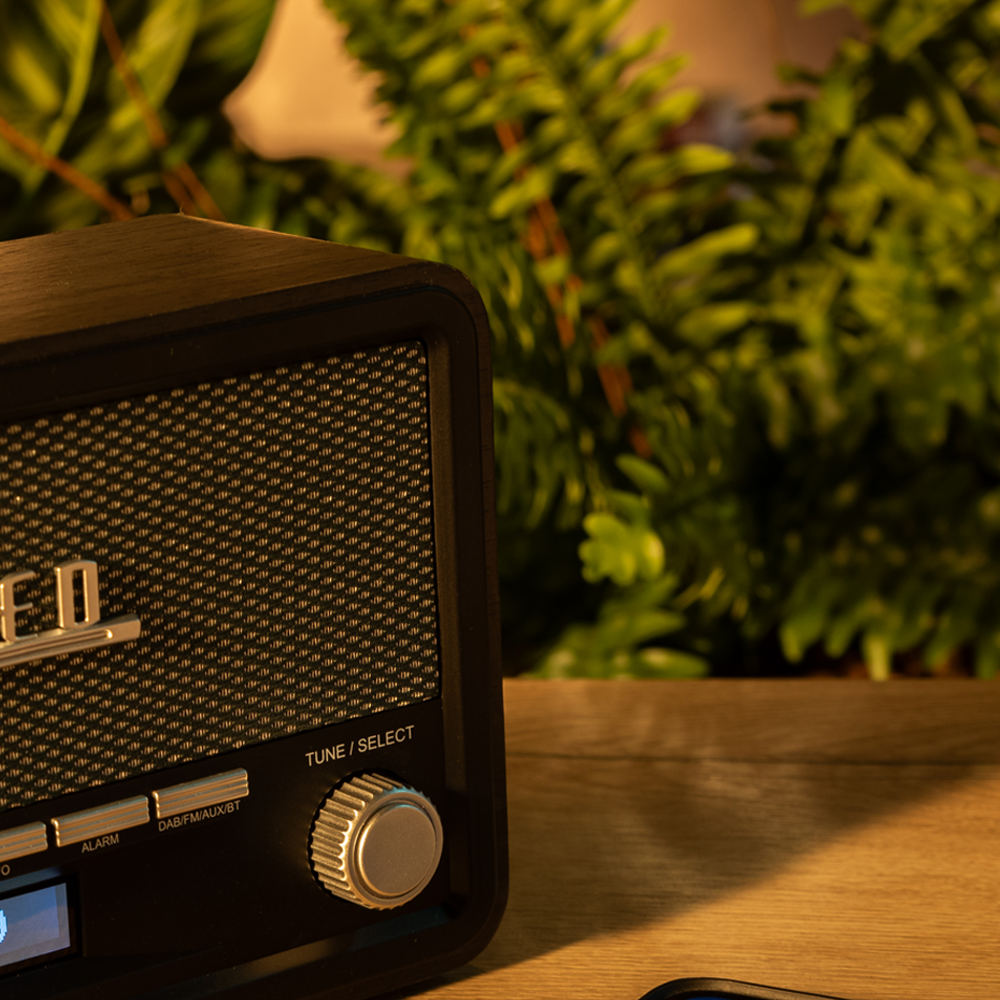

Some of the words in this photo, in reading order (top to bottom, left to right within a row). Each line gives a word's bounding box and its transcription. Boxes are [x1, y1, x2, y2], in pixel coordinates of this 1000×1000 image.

[305, 743, 346, 767] TUNE
[349, 741, 355, 756] /
[357, 724, 415, 753] SELECT
[157, 800, 242, 832] DAB/FM/AUX/BT
[81, 833, 120, 853] ALARM
